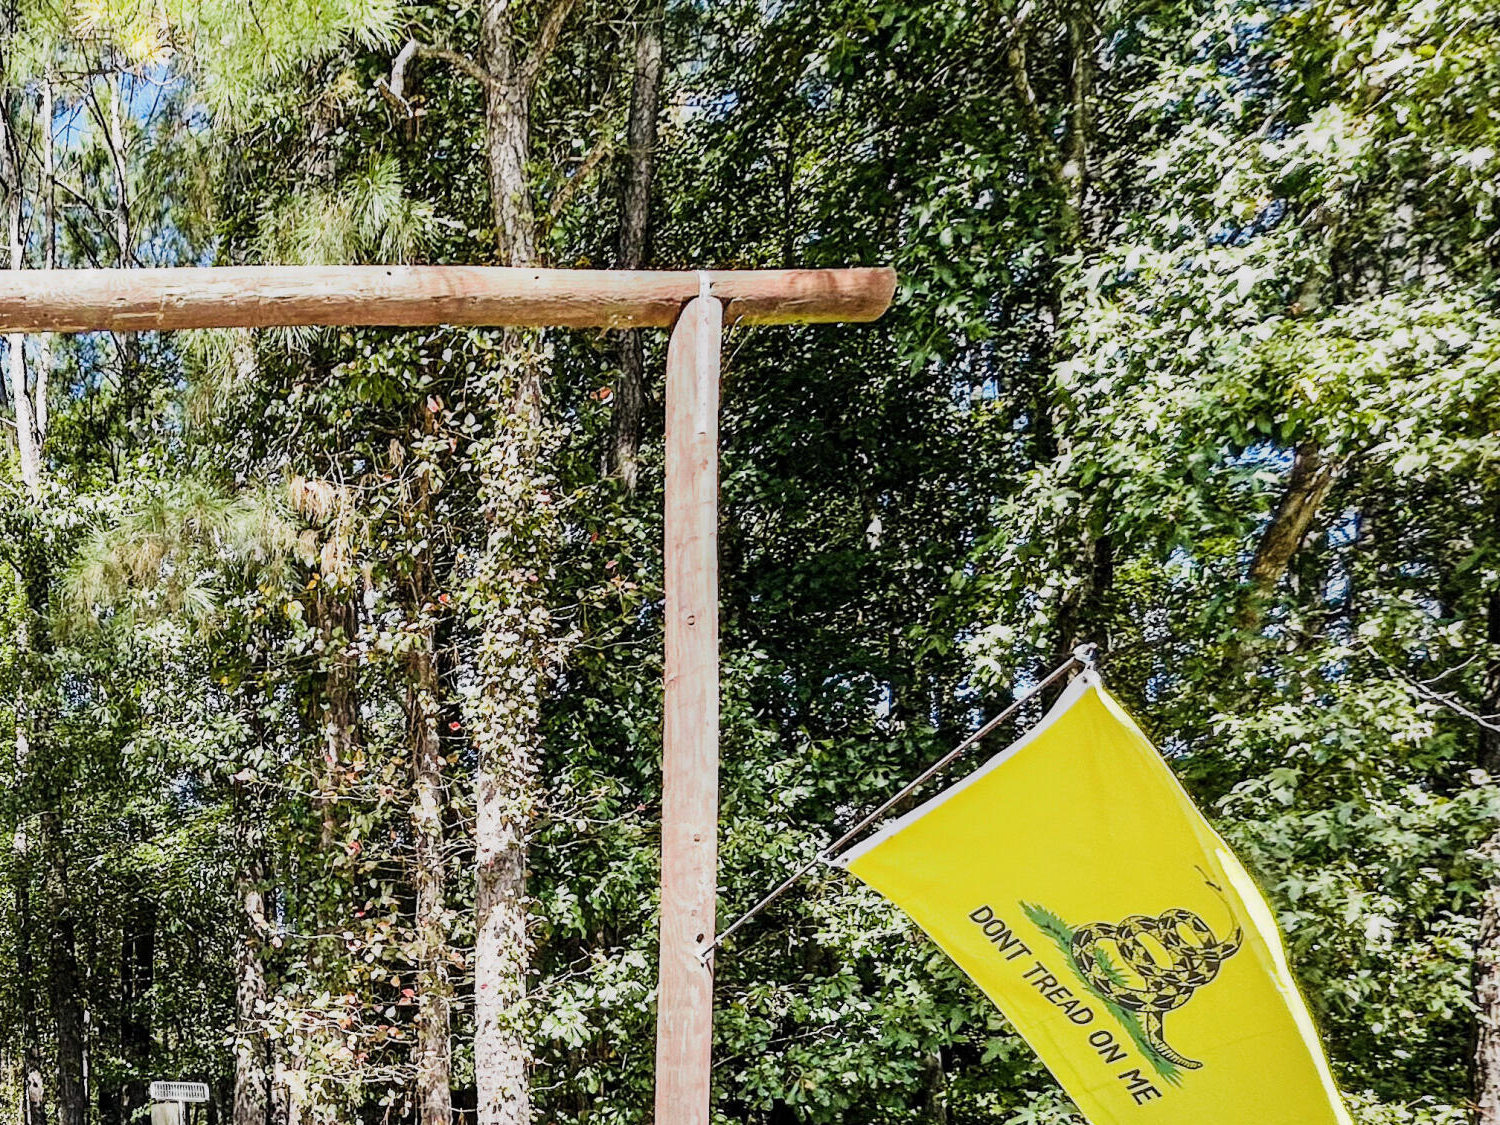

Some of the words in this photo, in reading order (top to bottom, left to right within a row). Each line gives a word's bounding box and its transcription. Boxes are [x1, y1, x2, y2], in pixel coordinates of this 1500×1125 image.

[969, 905, 1032, 961] DONT
[1022, 961, 1094, 1025] TREAD
[1088, 1030, 1127, 1064] ON
[1118, 1069, 1162, 1106] ME
